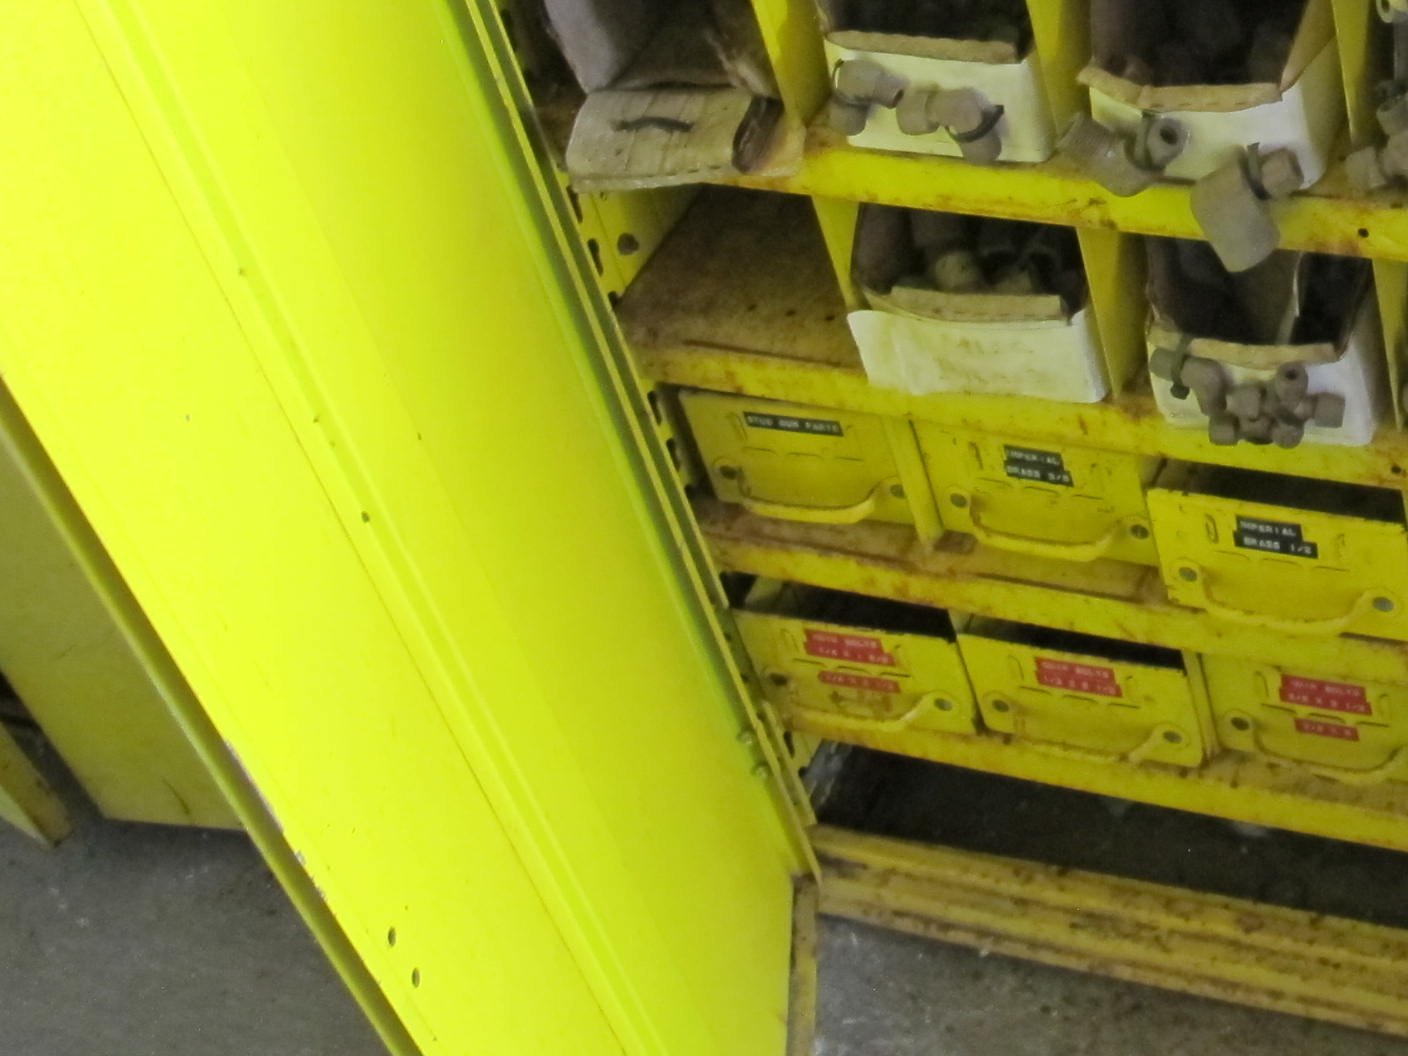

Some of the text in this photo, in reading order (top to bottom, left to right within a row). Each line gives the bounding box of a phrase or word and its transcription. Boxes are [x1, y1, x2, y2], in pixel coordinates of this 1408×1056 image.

[1006, 449, 1061, 466] IMPERIAL
[1006, 465, 1041, 479] BRASS
[1239, 520, 1297, 537] IMPERIAL
[1243, 536, 1312, 555] BRASS 1/2
